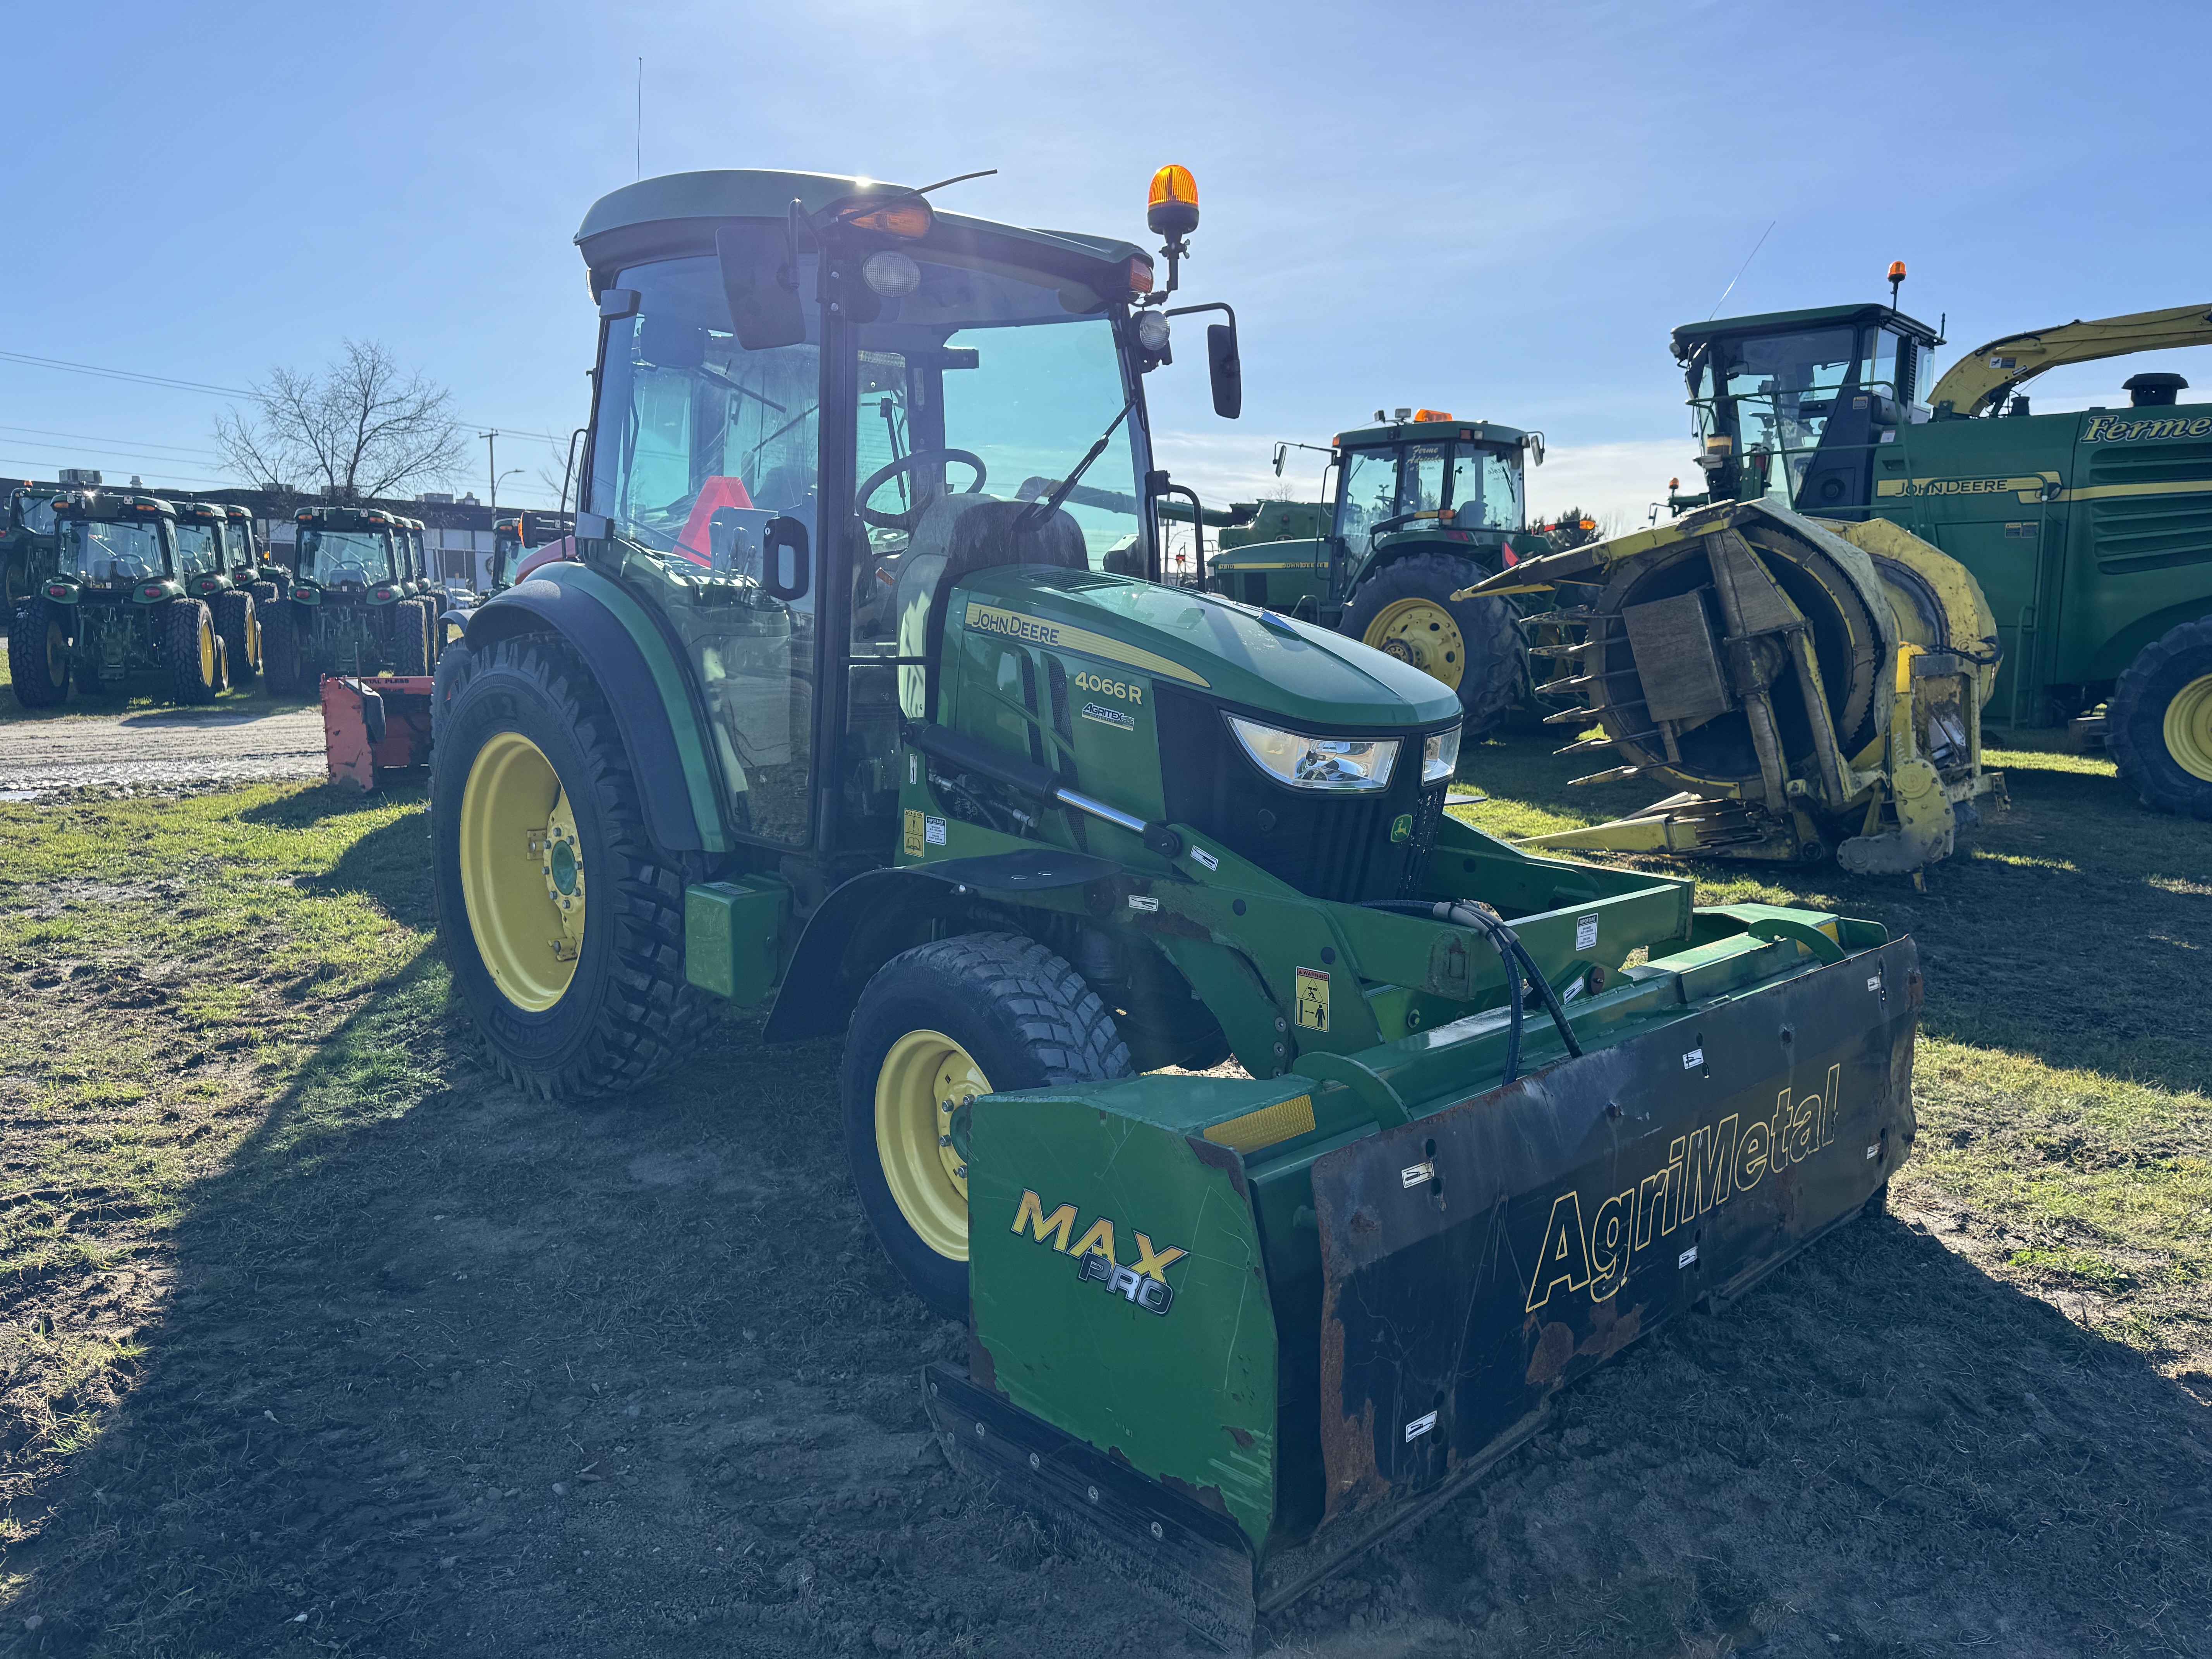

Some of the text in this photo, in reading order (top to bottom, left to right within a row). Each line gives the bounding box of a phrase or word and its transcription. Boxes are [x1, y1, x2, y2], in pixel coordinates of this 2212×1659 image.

[2080, 415, 2212, 443] Ferme
[1412, 445, 1438, 456] Ferme
[1895, 479, 2009, 496] JOHN DEERE
[973, 610, 1060, 645] JOHN DEERE
[1083, 703, 1123, 721] AGRITEX
[1580, 916, 1596, 924] IMPORTANT
[1304, 970, 1327, 979] WARNING
[1526, 1063, 1840, 1313] AgriMetal
[1011, 1188, 1189, 1286] MAX
[1078, 1251, 1173, 1314] PRO
